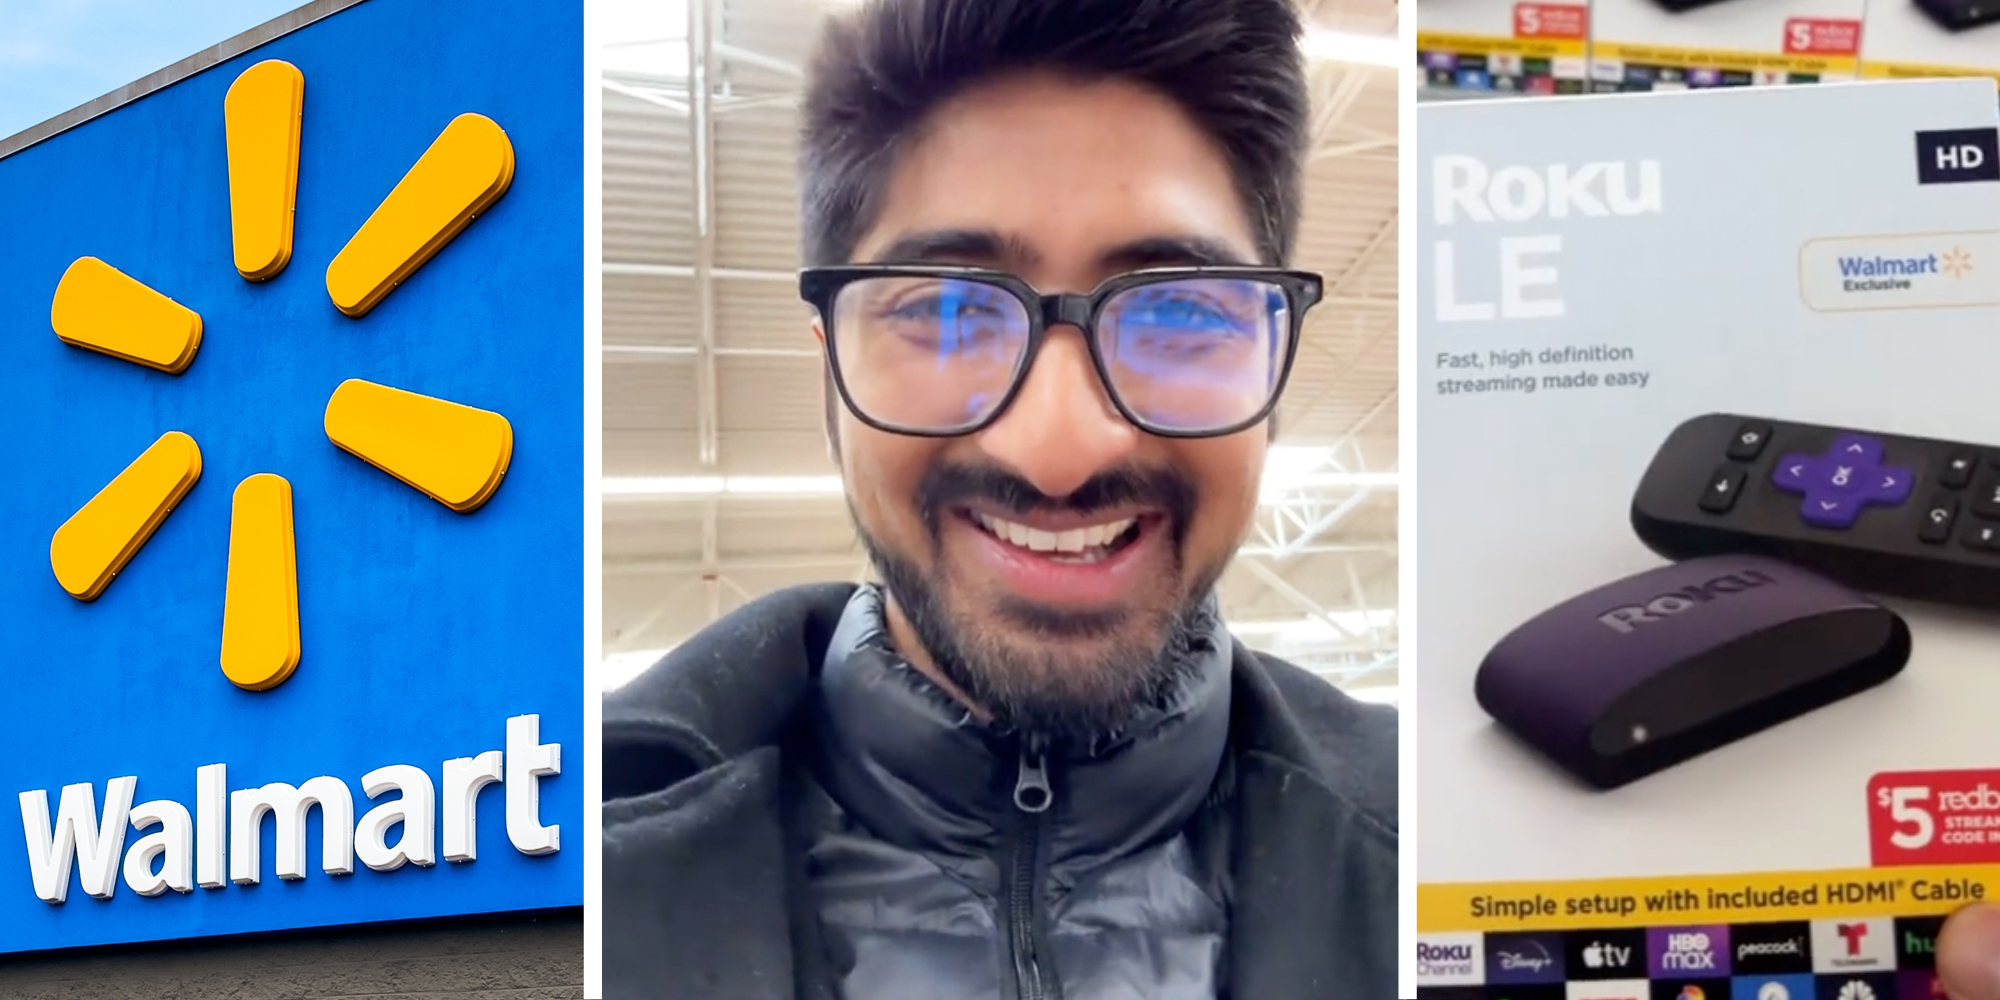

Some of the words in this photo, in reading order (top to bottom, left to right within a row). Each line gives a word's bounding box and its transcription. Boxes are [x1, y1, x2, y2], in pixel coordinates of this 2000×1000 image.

[1936, 144, 1984, 169] HD
[1838, 254, 1938, 277] Walmart
[1435, 234, 1565, 322] LE
[1843, 278, 1911, 292] Exclusive
[1436, 351, 1484, 370] Fast,
[1490, 348, 1533, 369] high
[1539, 345, 1633, 364] definition
[1437, 374, 1536, 395] streaming
[1543, 370, 1599, 389] made
[1605, 370, 1650, 389] easy
[1832, 465, 1853, 485] OK
[18, 713, 561, 904] Walmart
[1942, 831, 1986, 844] CODE
[1470, 893, 1557, 920] Simple
[1565, 894, 1636, 917] setup
[1645, 889, 1699, 913] with
[1707, 884, 1817, 909] included
[1911, 877, 1985, 900] Cable
[1668, 933, 1710, 951] HBO
[1737, 939, 1799, 961] peacock
[1417, 961, 1472, 976] Channel
[1662, 951, 1715, 969] max
